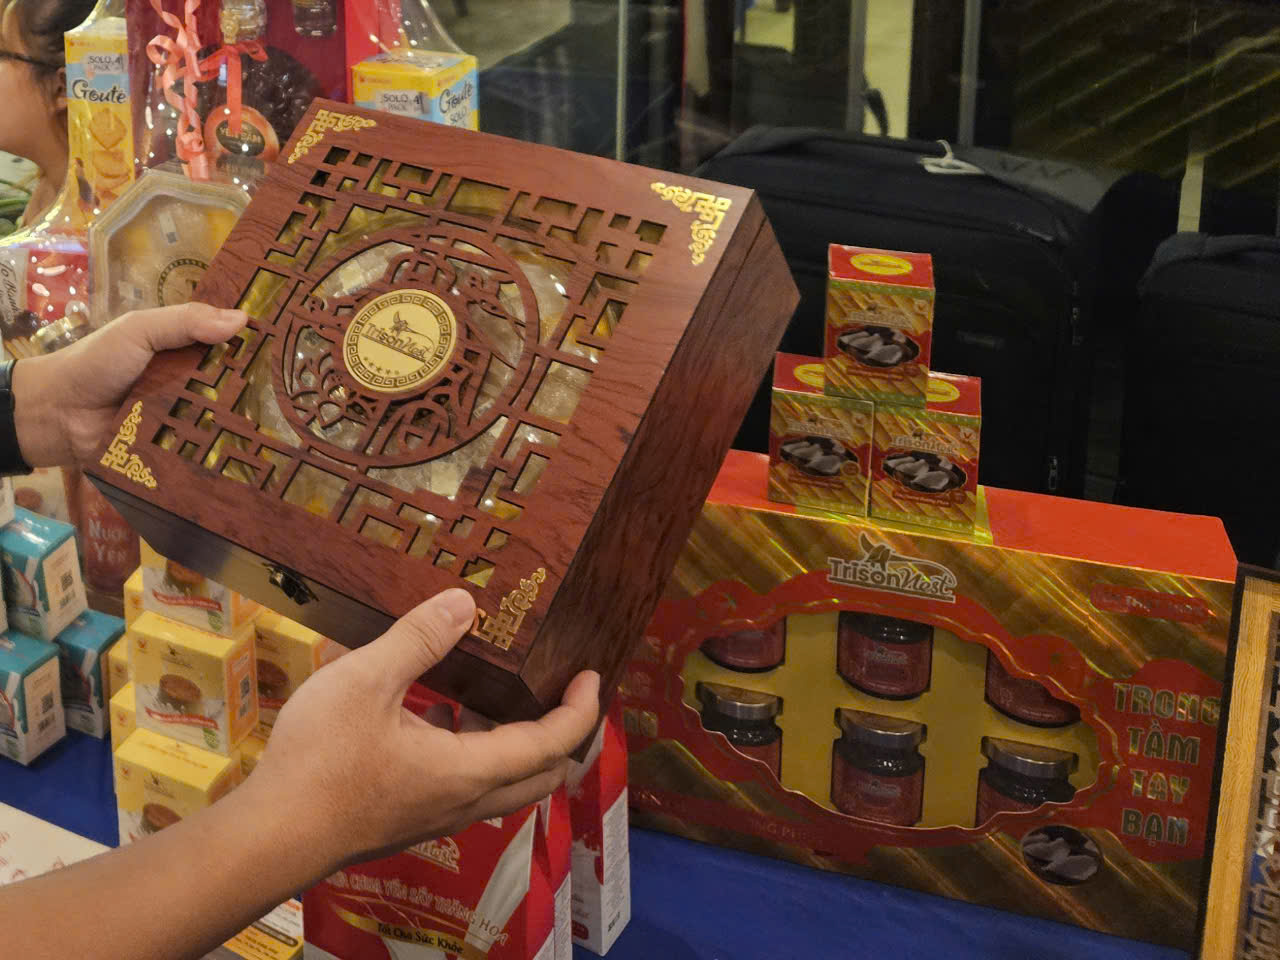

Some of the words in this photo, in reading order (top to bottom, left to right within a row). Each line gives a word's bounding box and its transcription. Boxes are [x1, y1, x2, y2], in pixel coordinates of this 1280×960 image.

[827, 556, 956, 599] TrisonNest
[1113, 682, 1220, 726] TRONG
[1131, 769, 1190, 803] TAY
[1122, 808, 1189, 847] BẠN
